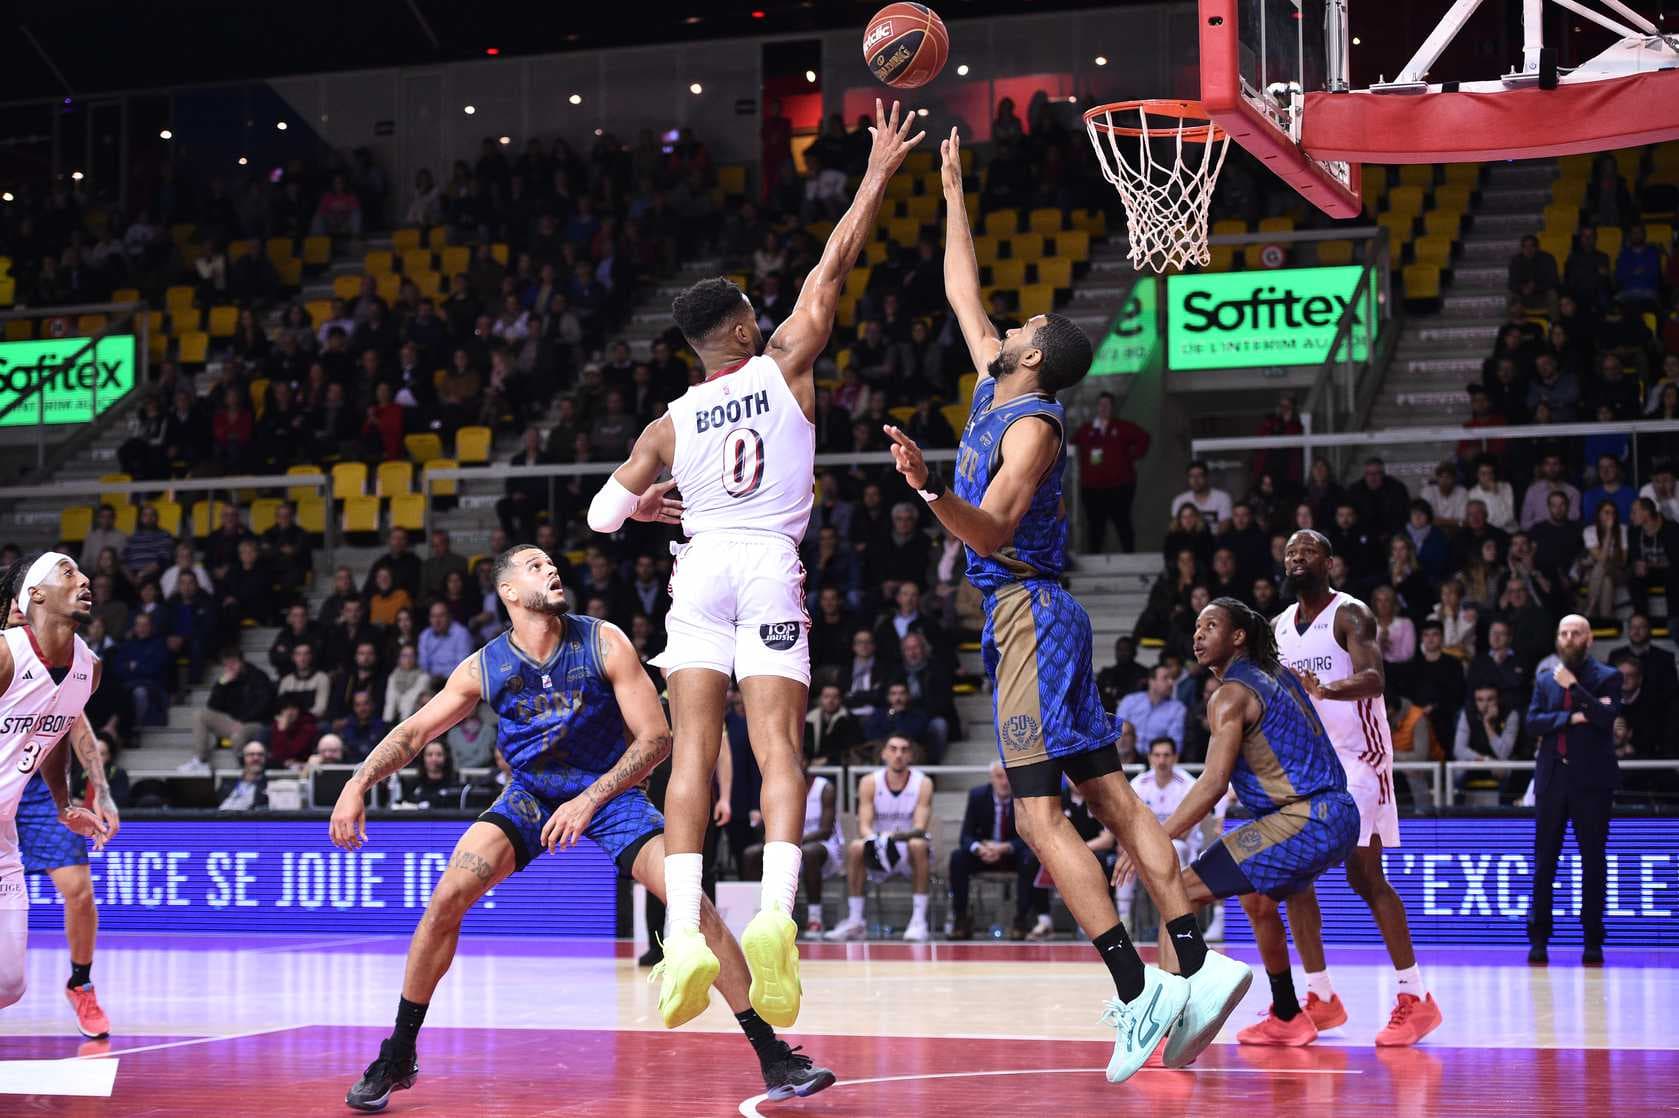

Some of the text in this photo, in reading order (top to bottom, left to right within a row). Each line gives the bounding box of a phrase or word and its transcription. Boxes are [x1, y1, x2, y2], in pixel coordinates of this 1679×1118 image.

[1183, 286, 1361, 333] Sofitex
[696, 389, 770, 434] BOOTH
[722, 427, 765, 499] 0
[766, 623, 796, 635] TOP
[206, 852, 259, 907] SE
[275, 852, 386, 907] JOUE
